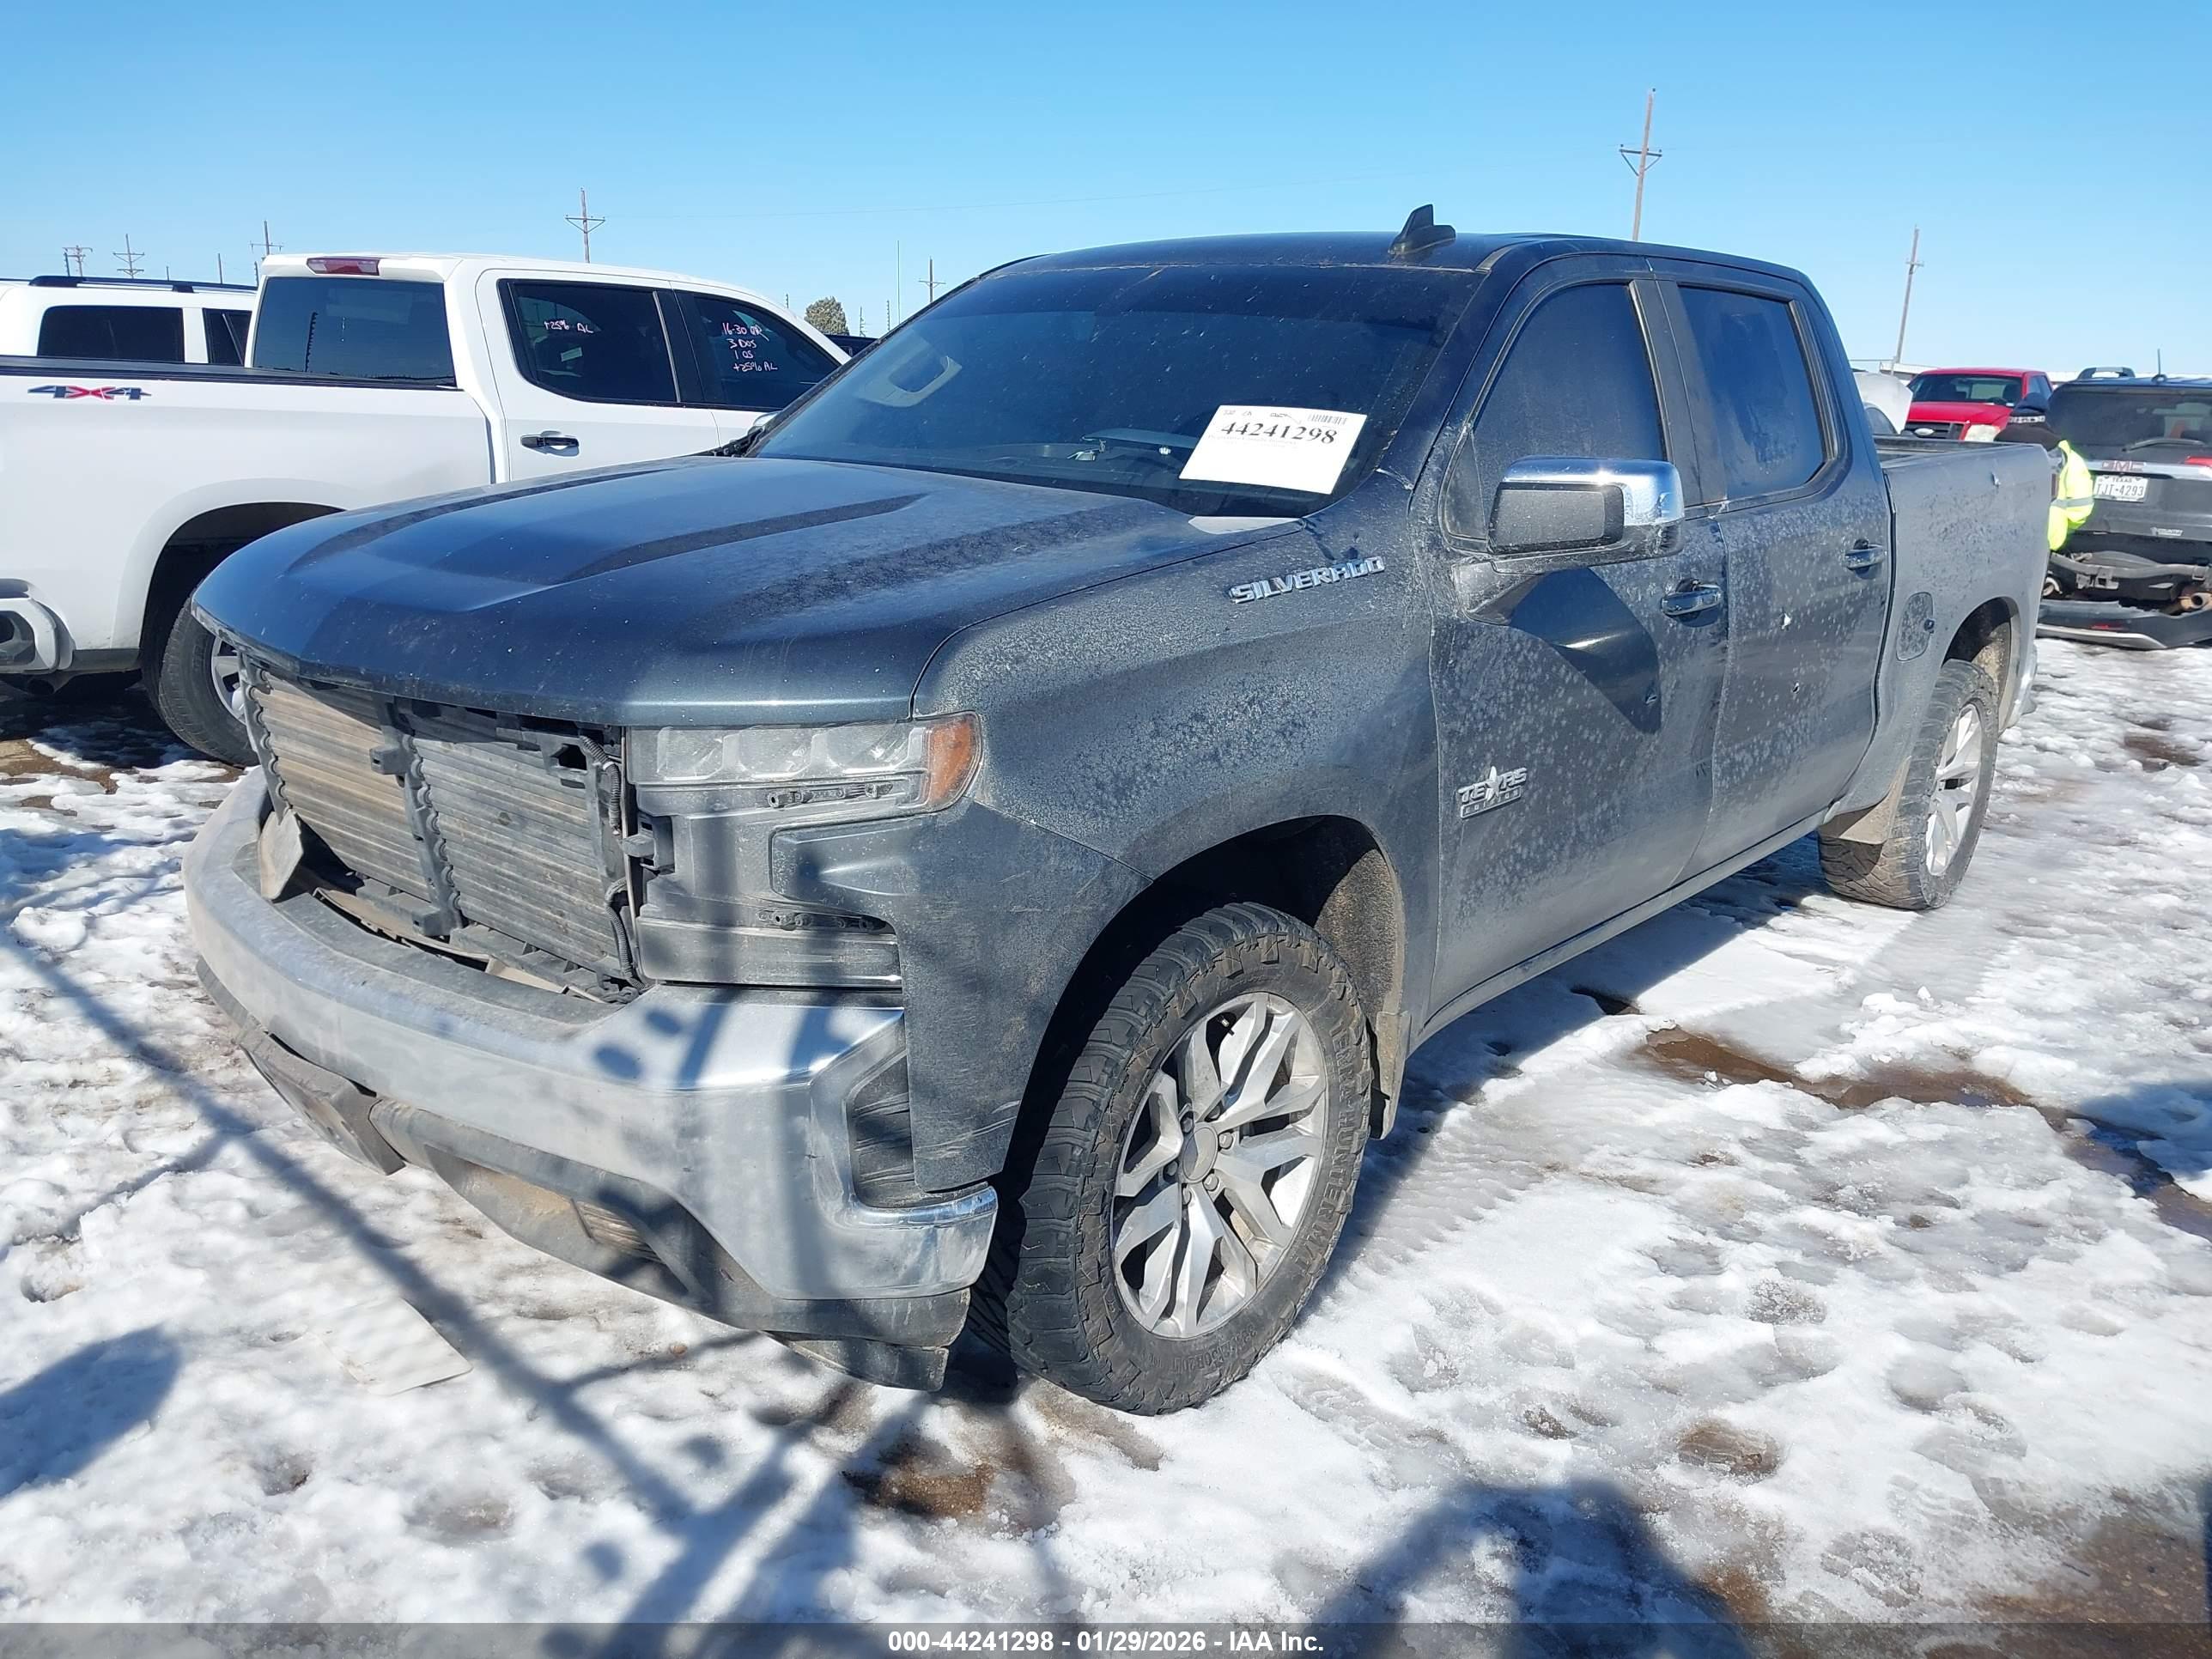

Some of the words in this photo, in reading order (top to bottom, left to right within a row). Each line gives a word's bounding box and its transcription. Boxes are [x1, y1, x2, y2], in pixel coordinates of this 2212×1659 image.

[726, 337, 738, 349] 3
[1221, 422, 1338, 445] 44241298
[1228, 555, 1387, 605] SILVERADO
